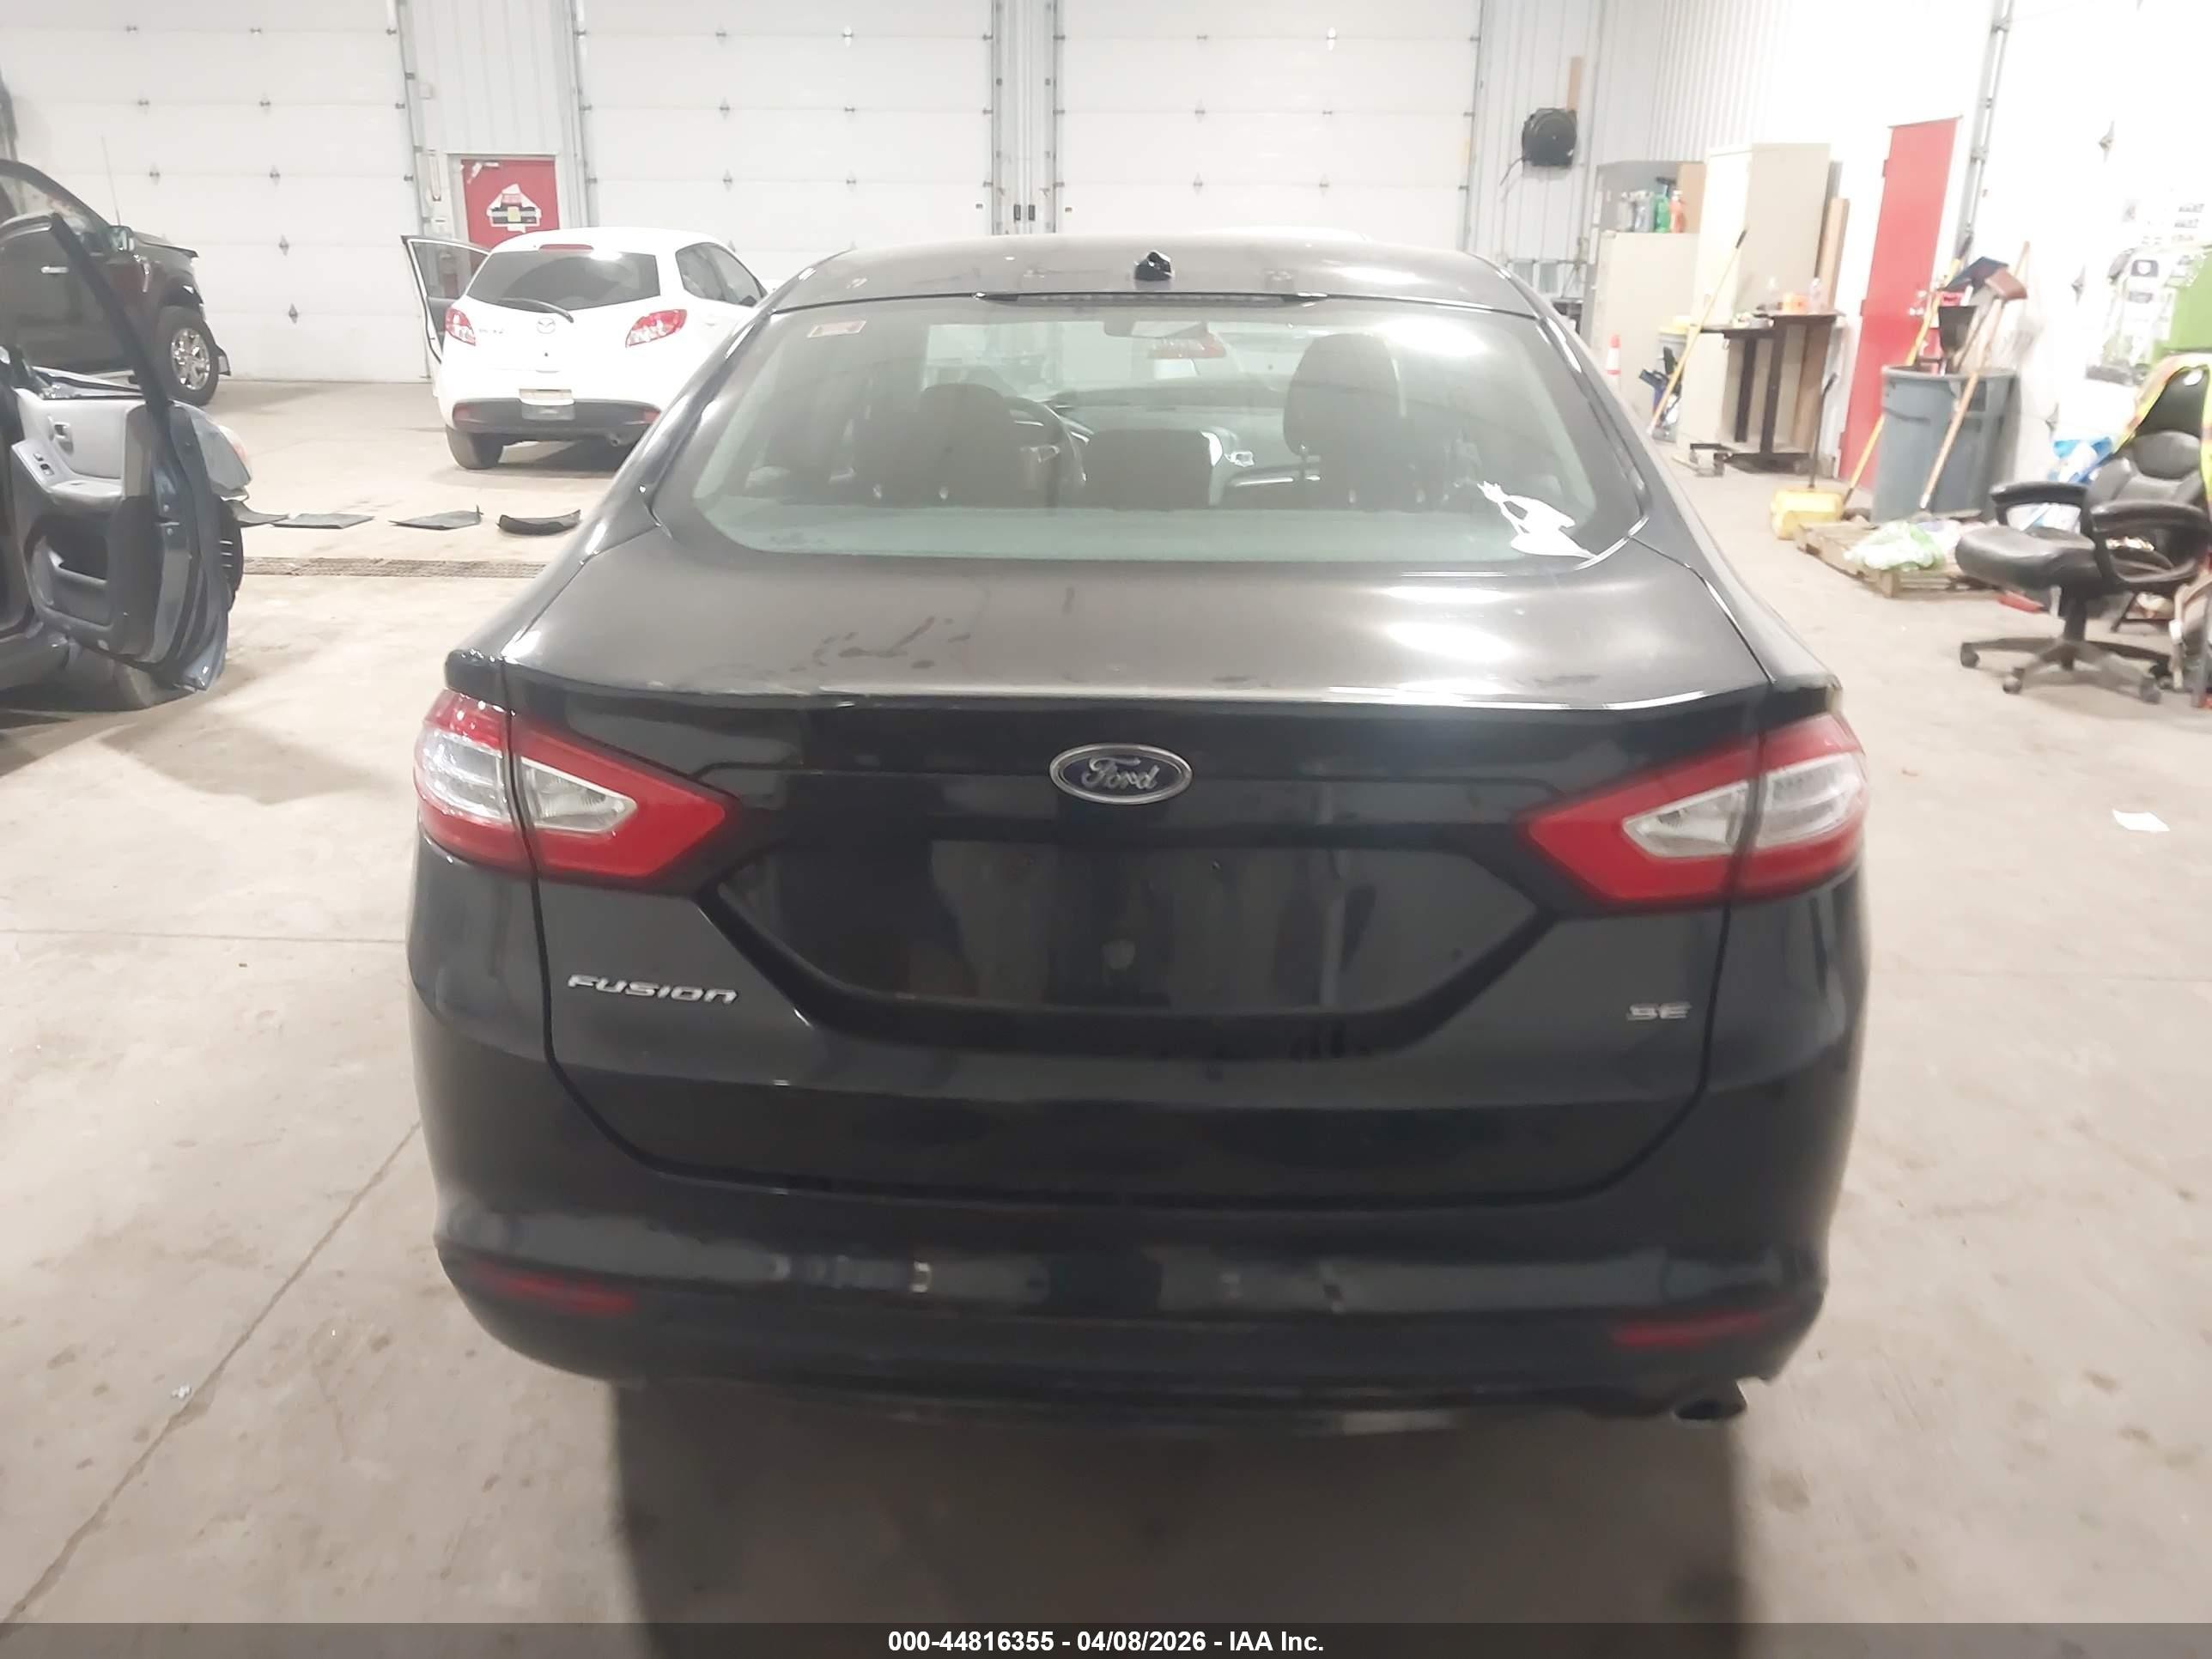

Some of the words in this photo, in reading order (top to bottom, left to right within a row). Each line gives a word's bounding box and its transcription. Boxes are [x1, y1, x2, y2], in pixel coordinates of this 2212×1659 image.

[1081, 756, 1160, 790] Ford
[568, 974, 738, 1004] FUSION
[1627, 1001, 1692, 1021] SE
